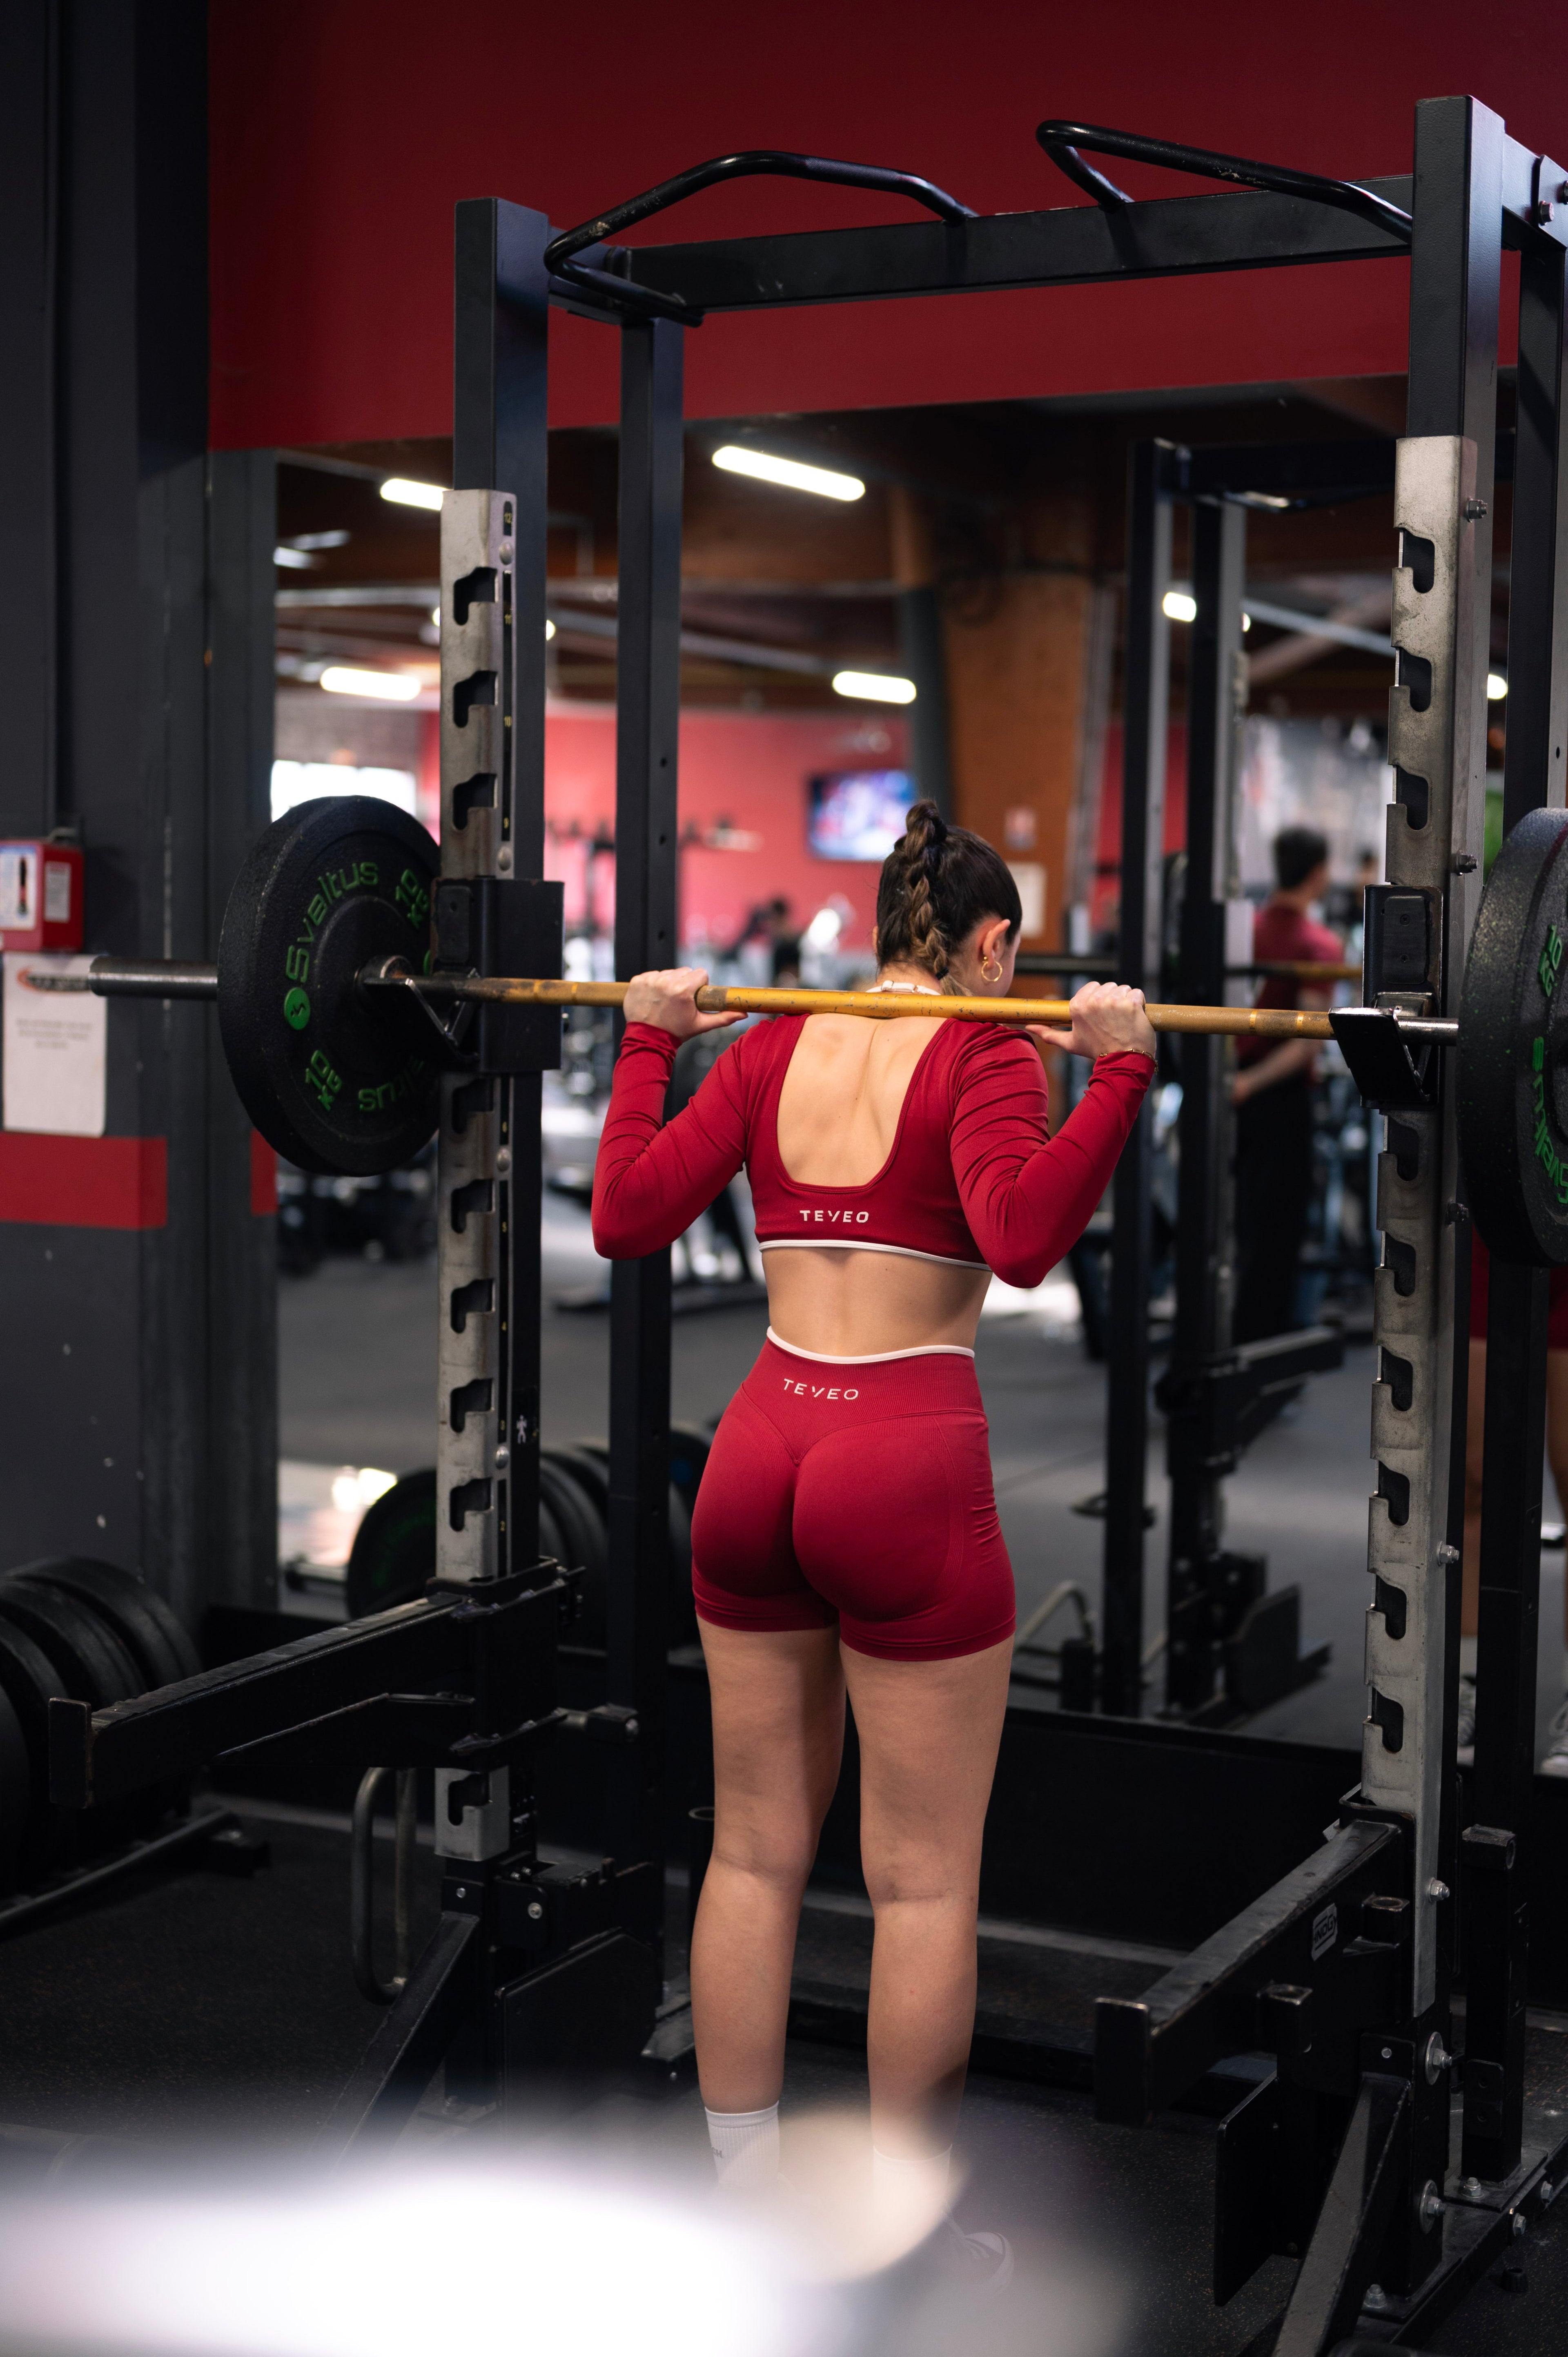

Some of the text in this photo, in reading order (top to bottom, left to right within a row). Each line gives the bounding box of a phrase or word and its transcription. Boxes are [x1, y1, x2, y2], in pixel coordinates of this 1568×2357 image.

[395, 868, 419, 907] 10
[1548, 924, 1562, 971] 10
[305, 1050, 330, 1090] 10
[800, 1210, 869, 1223] TEVEO
[784, 1378, 859, 1400] TEVEO
